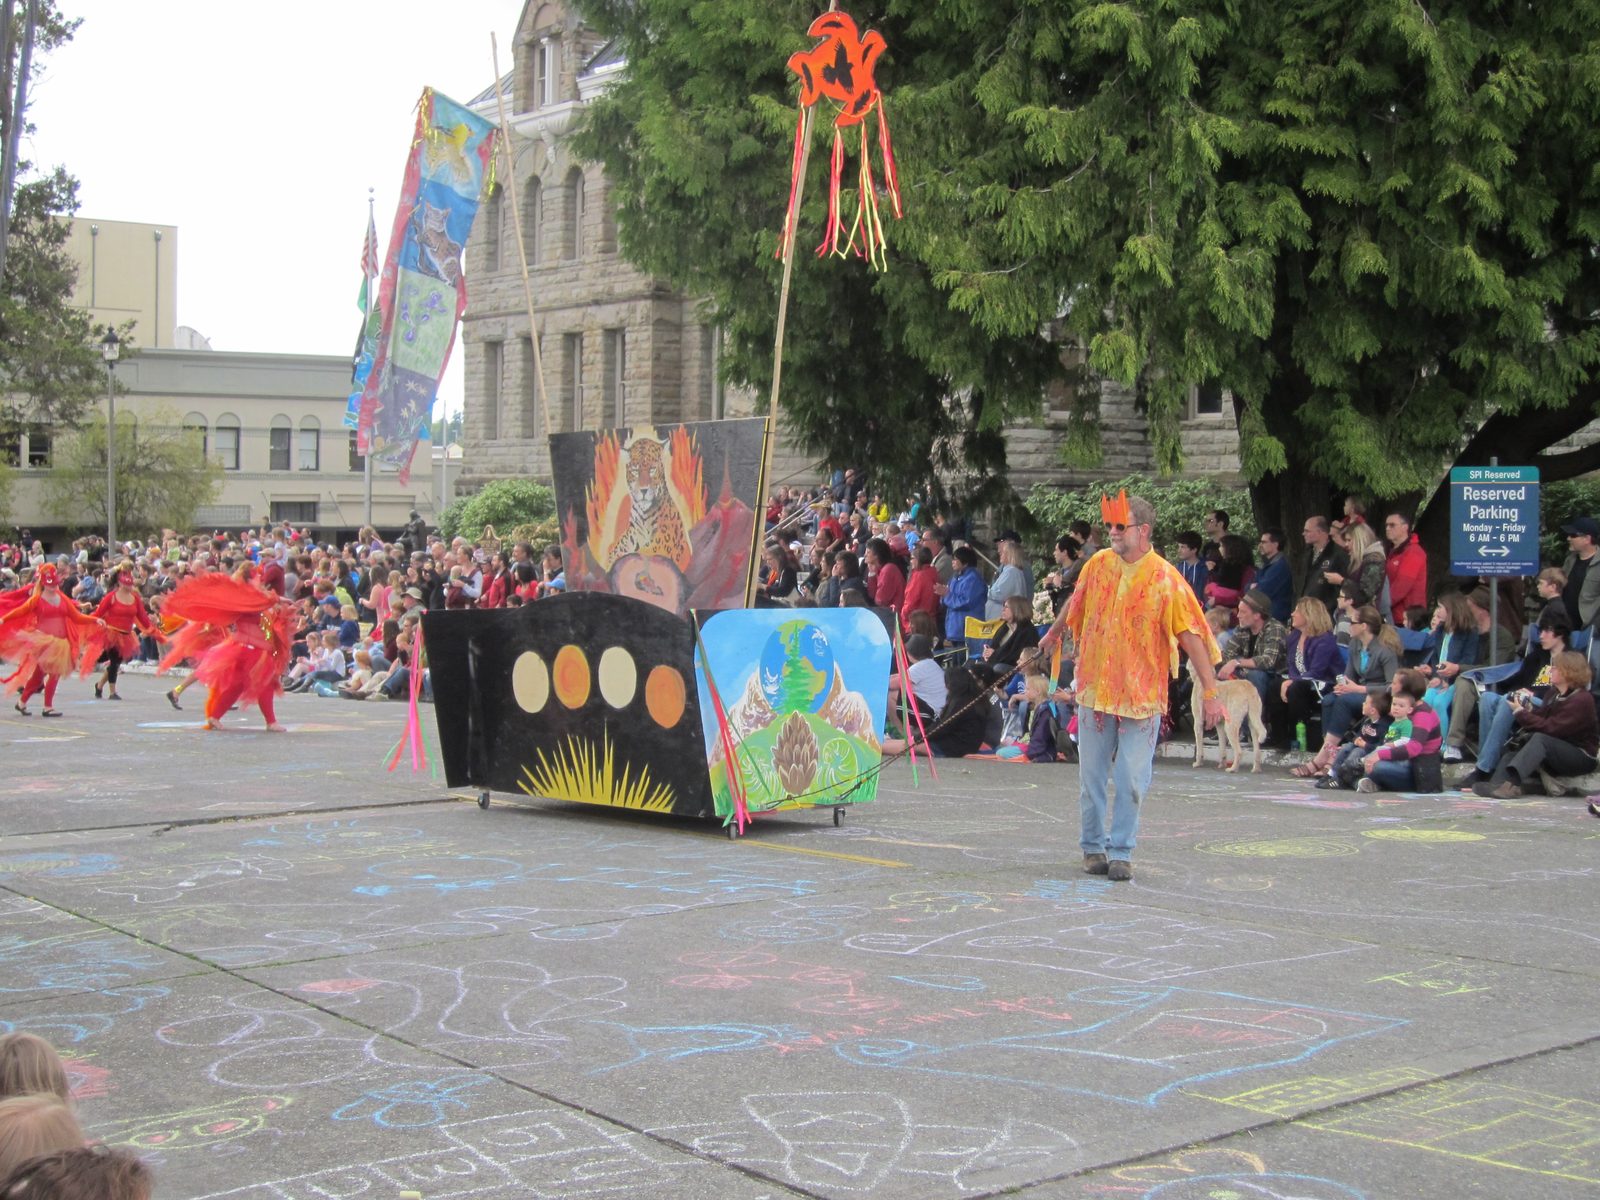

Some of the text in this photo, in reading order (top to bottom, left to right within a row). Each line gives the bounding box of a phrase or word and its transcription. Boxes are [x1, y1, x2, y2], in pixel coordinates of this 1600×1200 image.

[1469, 470, 1521, 479] SPI Reserved
[1463, 486, 1526, 501] Reserved
[1470, 505, 1519, 522] Parking
[1463, 523, 1493, 533] Monday
[1502, 523, 1527, 533] Friday
[1469, 533, 1476, 542] 6
[1477, 533, 1490, 542] AM
[1499, 533, 1506, 542] 6
[1507, 533, 1520, 542] PM
